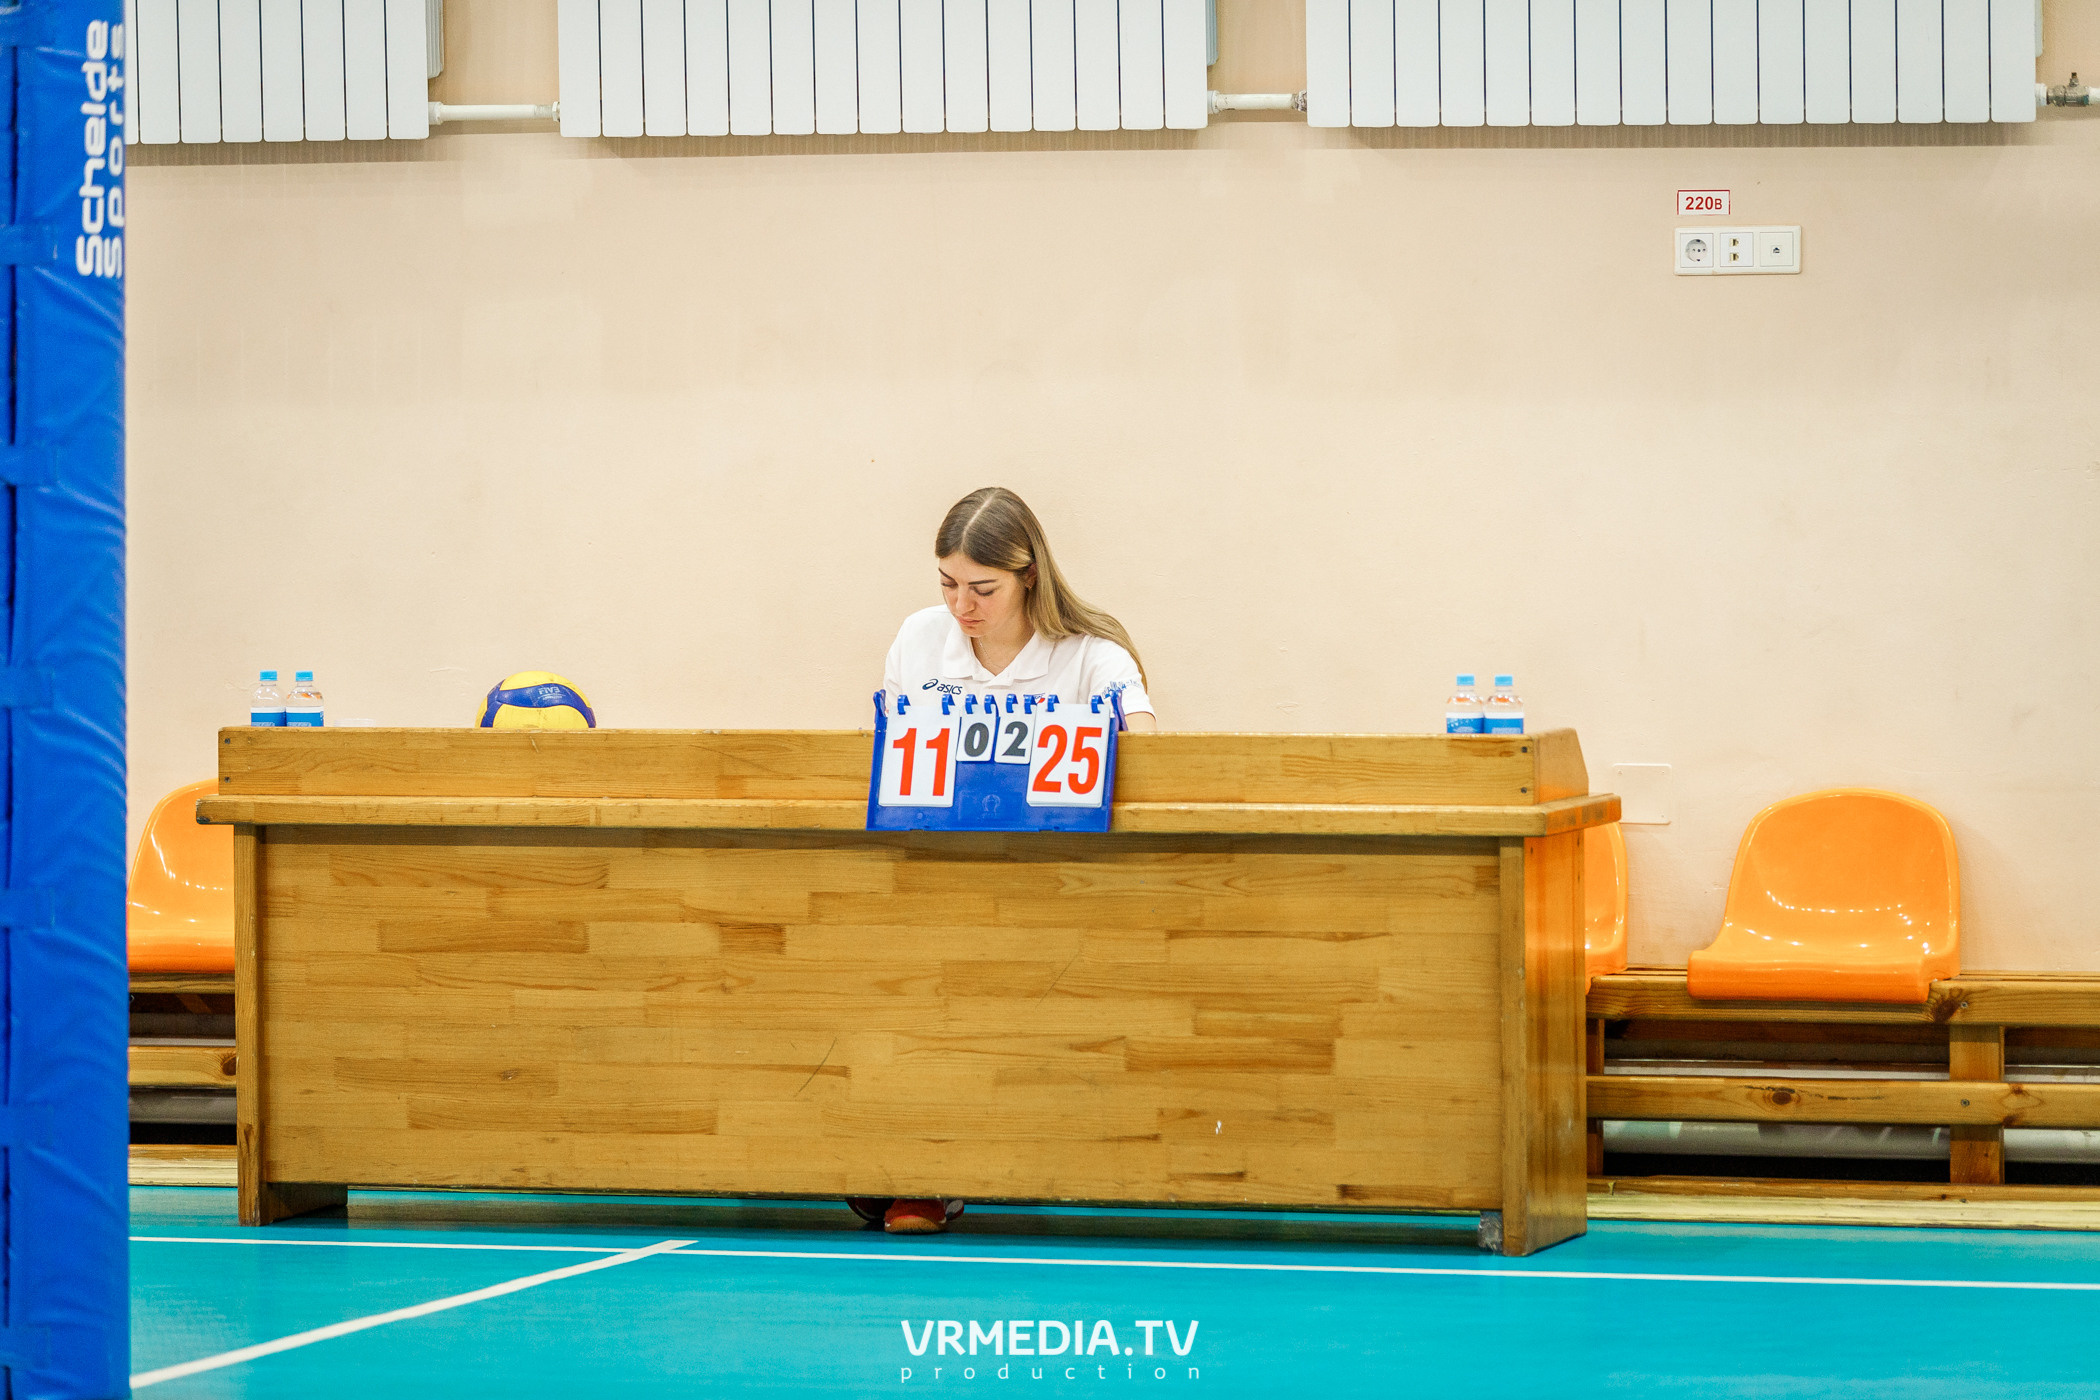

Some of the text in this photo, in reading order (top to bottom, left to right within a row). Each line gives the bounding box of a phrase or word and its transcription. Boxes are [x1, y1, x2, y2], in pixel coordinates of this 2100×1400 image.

[75, 19, 108, 277] Schelde
[936, 683, 963, 696] asics
[892, 721, 1103, 797] 11 0 2 25
